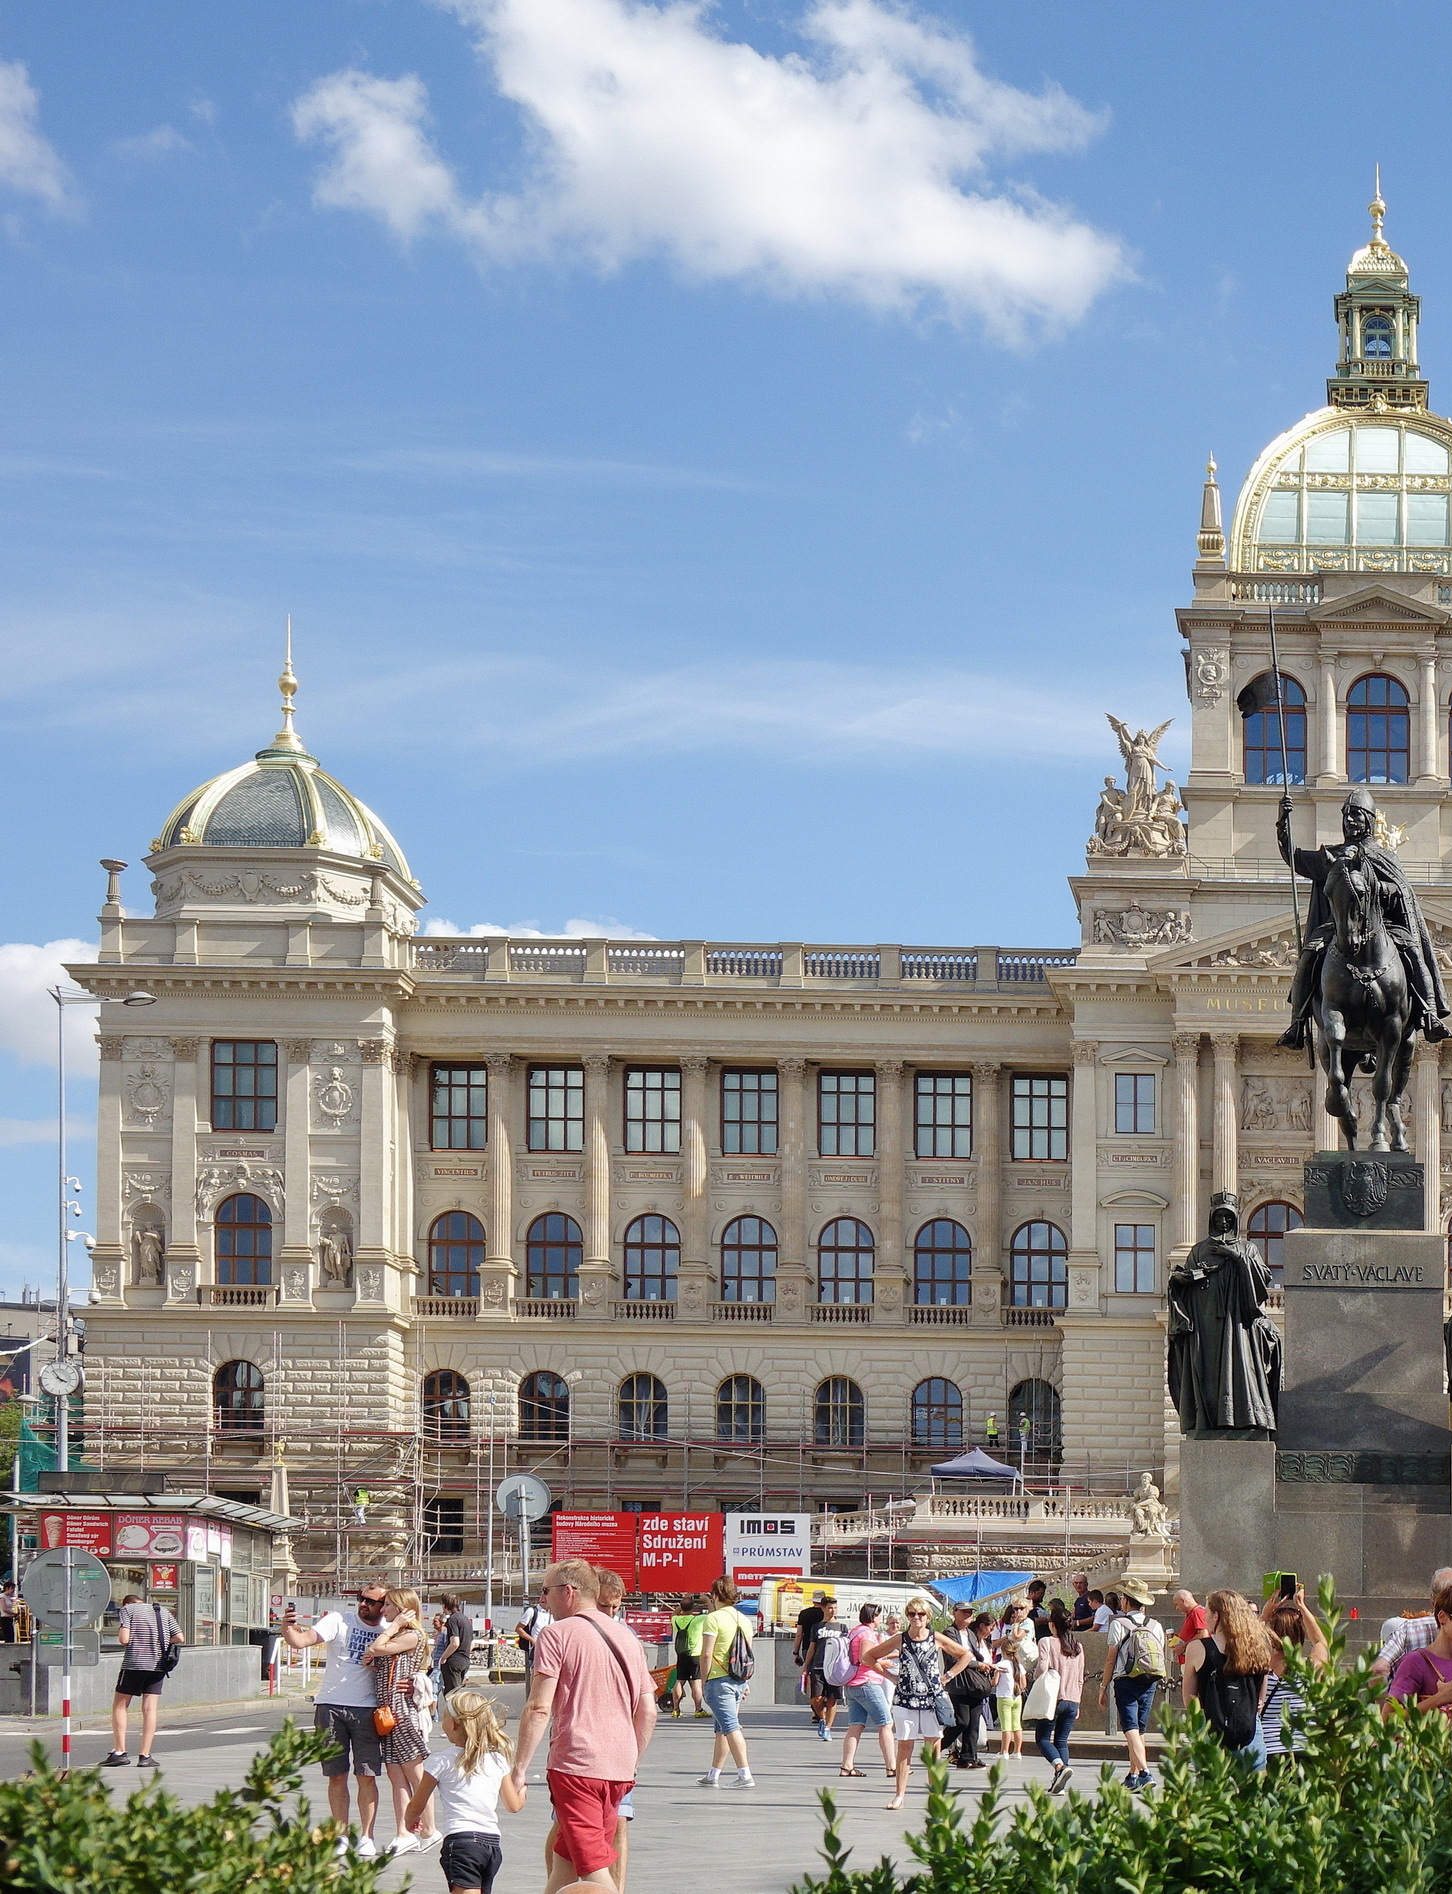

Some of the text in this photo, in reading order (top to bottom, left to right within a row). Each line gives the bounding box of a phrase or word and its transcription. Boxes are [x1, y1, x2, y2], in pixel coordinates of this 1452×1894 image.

[1206, 997, 1288, 1013] MUSEU
[1303, 1261, 1424, 1283] SVATÝ VÁCLAVE
[117, 1514, 150, 1524] DÖNER
[151, 1515, 183, 1525] KEBAB
[642, 1516, 710, 1532] zde staví
[740, 1519, 796, 1535] IMOS
[642, 1533, 709, 1549] Sdružení
[741, 1545, 803, 1557] PRŮMSTAV
[642, 1552, 684, 1568] M-P-I
